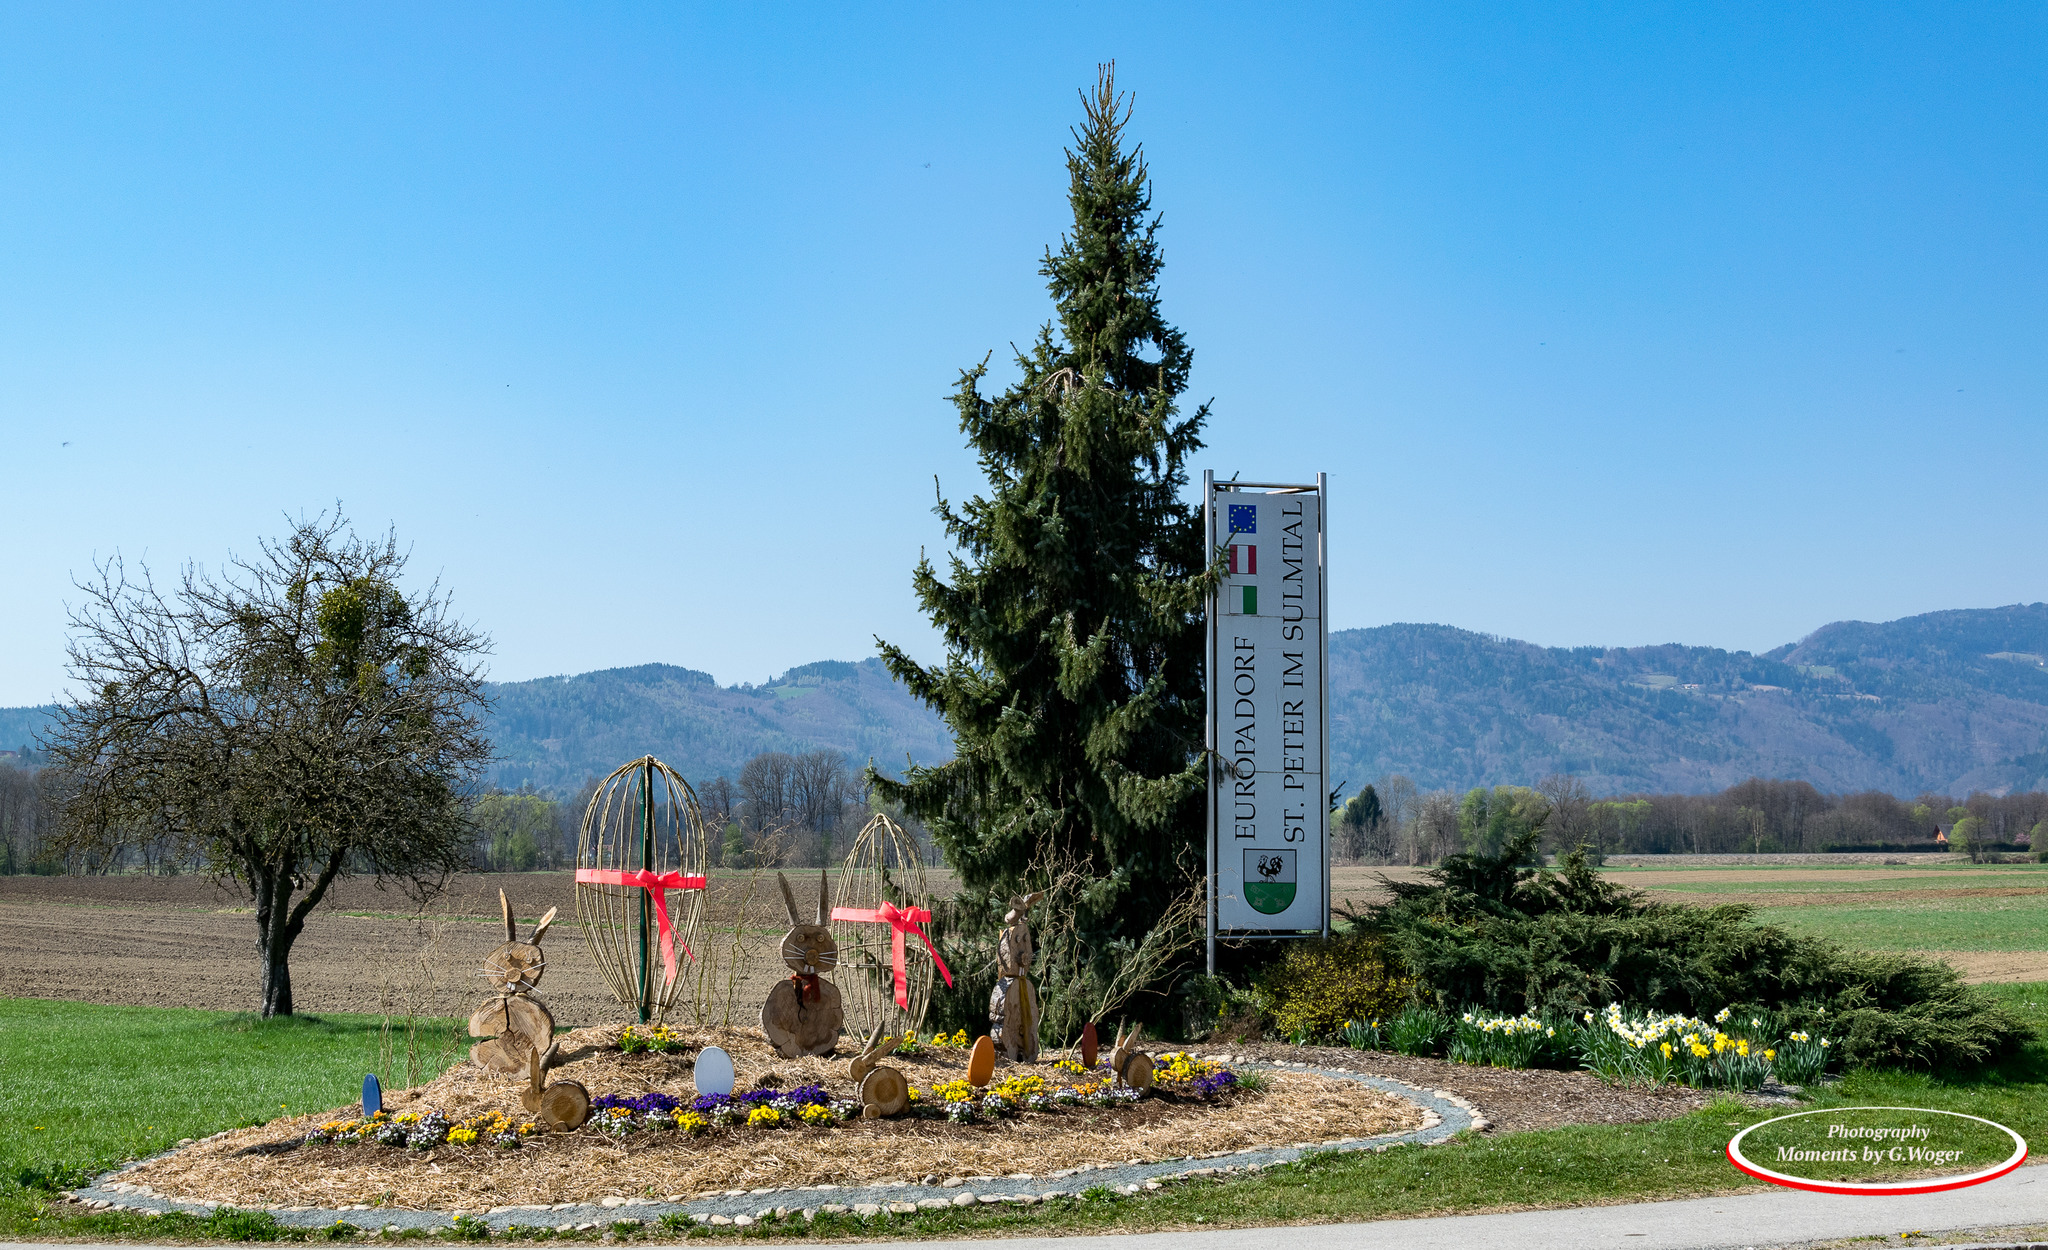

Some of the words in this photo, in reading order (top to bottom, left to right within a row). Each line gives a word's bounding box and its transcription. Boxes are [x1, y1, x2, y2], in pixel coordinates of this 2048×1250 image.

[1282, 501, 1304, 641] SULMTAL
[1283, 651, 1304, 689] IM
[1234, 637, 1256, 841] EUROPADORF
[1283, 699, 1305, 792] PETER
[1284, 802, 1306, 842] ST.
